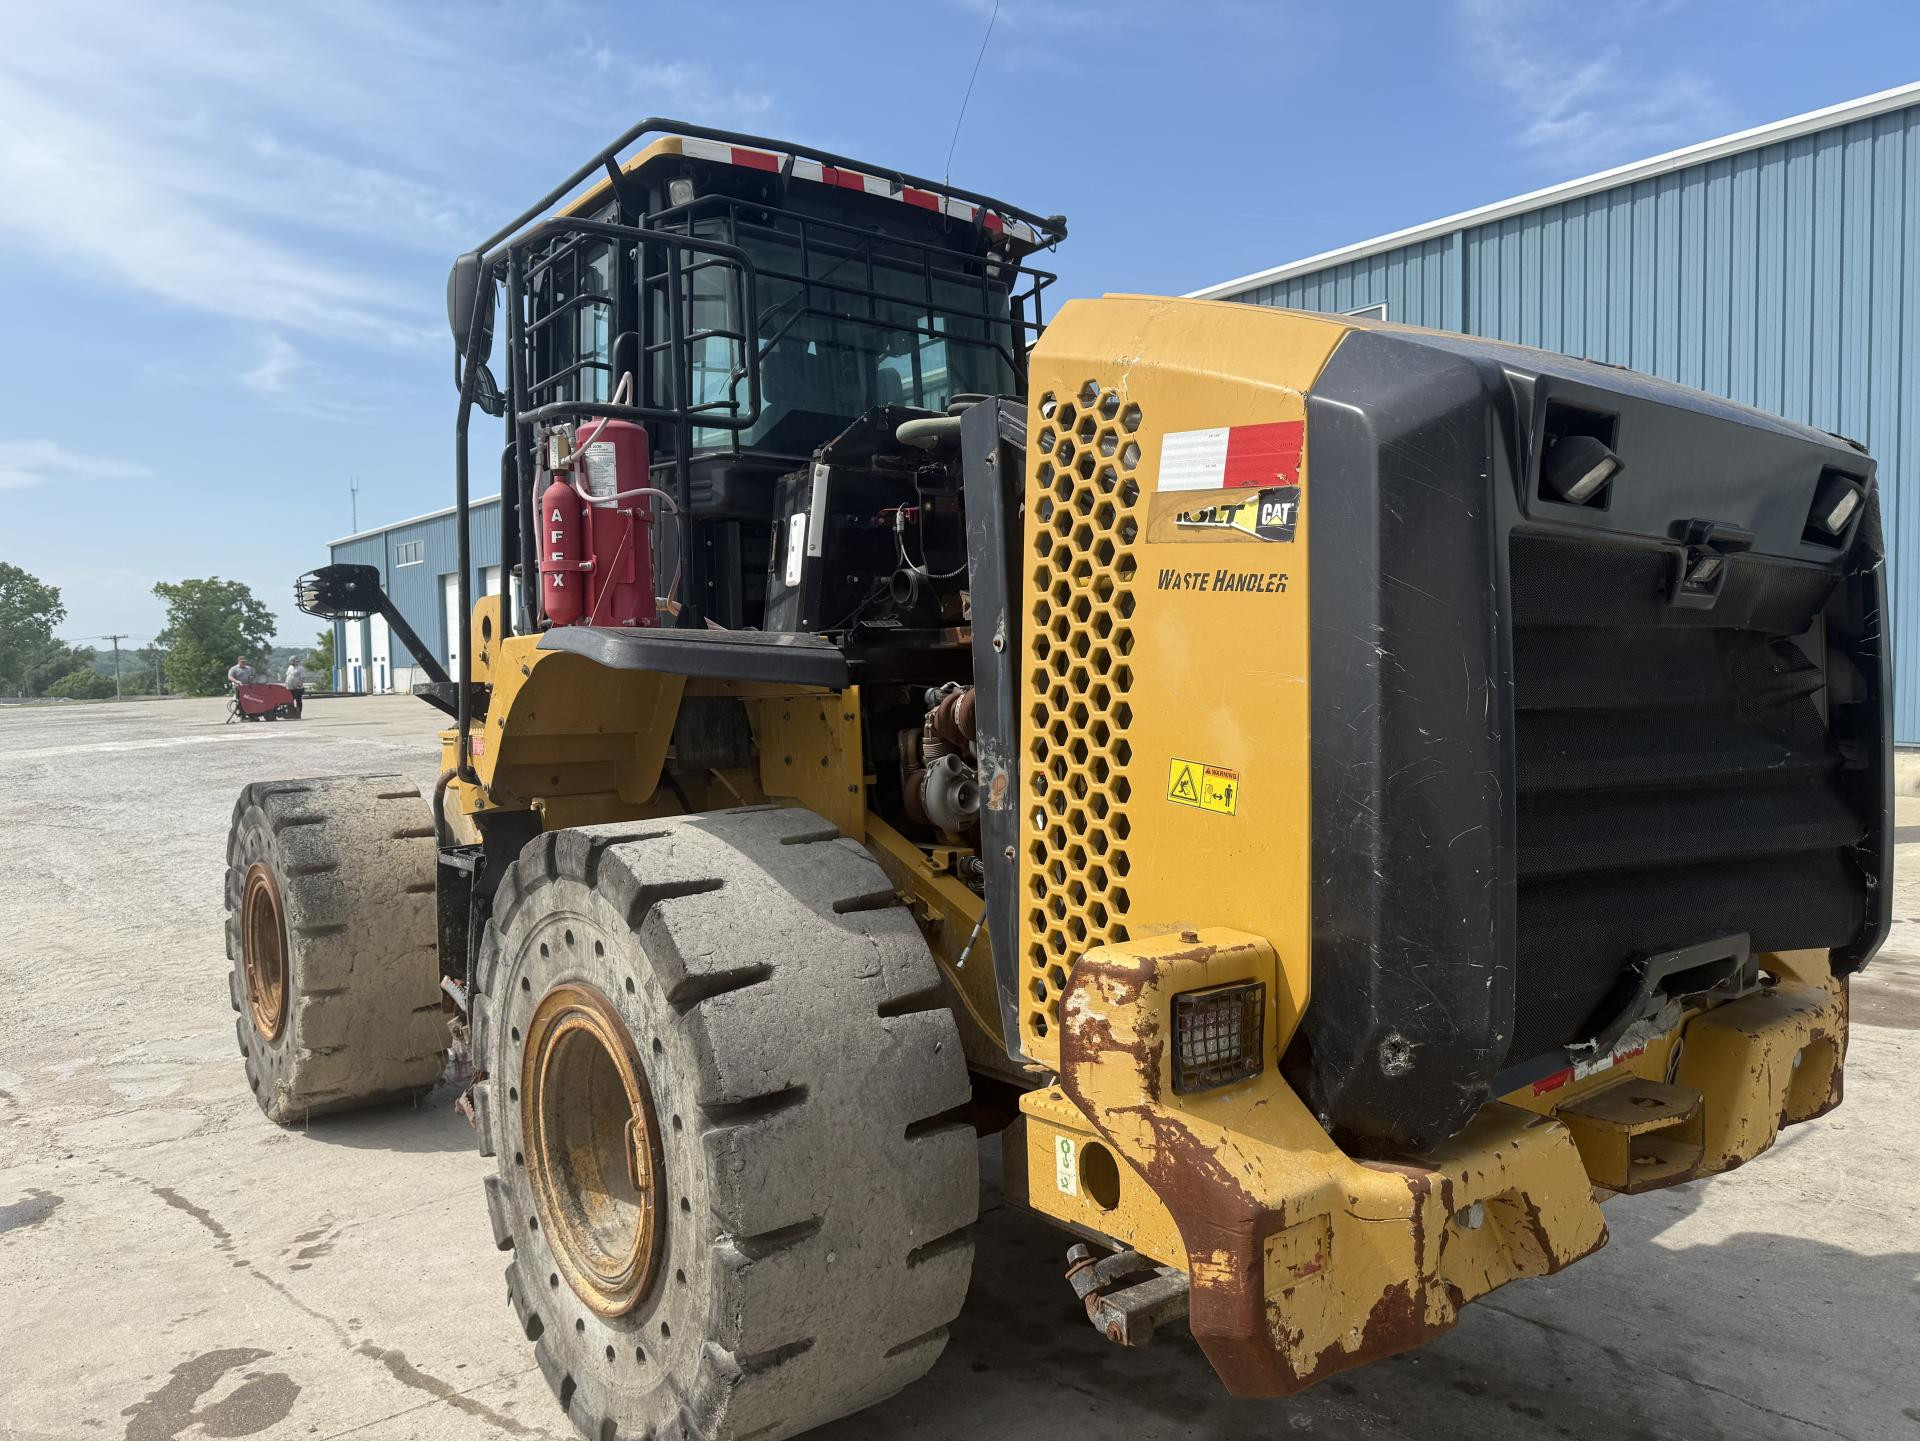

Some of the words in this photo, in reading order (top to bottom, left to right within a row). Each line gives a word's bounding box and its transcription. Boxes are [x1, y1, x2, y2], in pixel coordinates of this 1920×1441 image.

[1261, 503, 1293, 526] CAT
[1157, 569, 1211, 591] WASTE
[1212, 569, 1289, 593] HANDLER
[1211, 769, 1237, 780] WARNING
